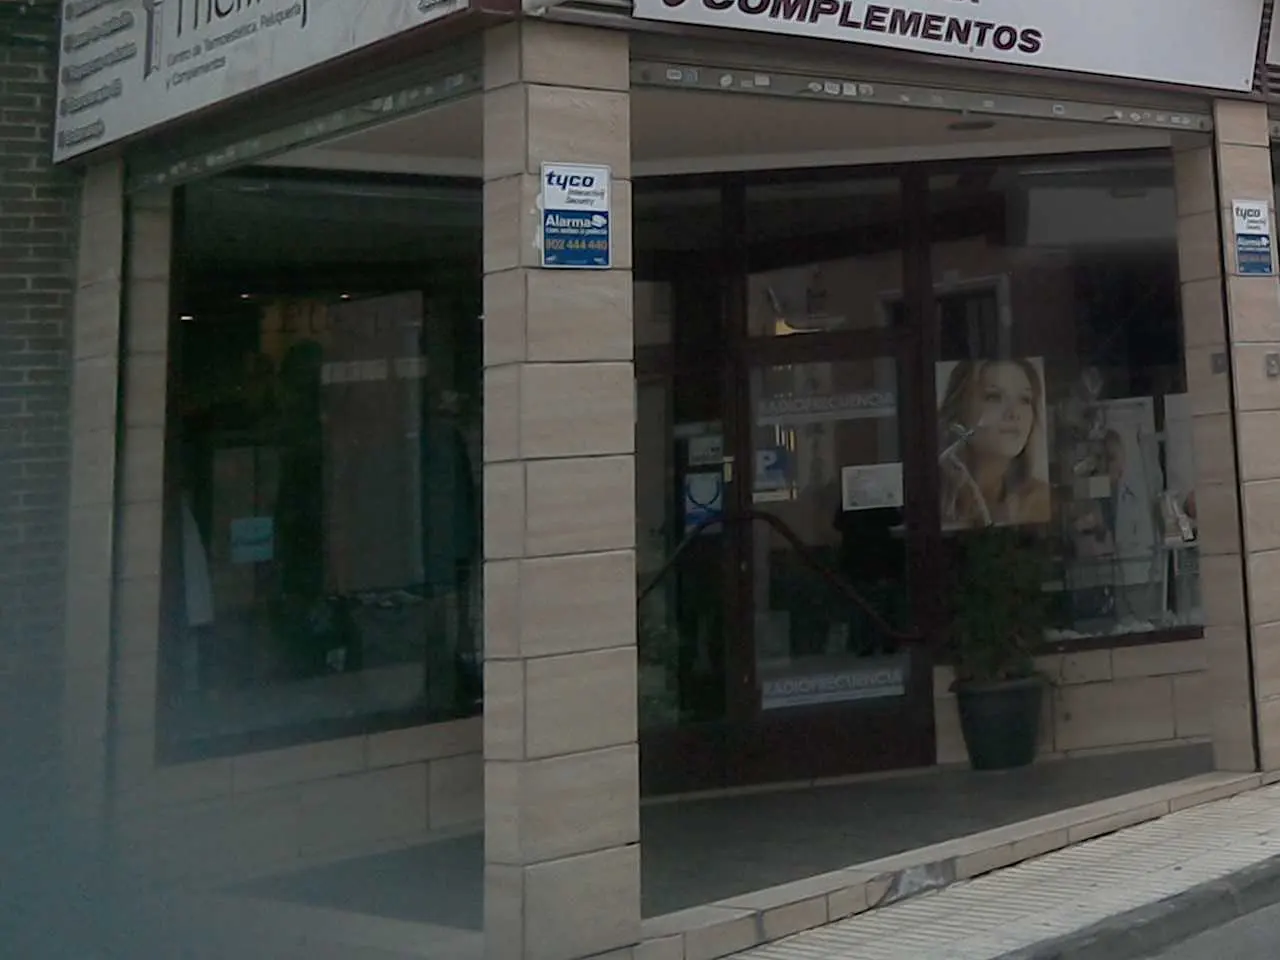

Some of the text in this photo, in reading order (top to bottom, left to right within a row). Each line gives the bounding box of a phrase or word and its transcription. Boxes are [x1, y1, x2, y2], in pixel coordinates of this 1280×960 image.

[546, 169, 596, 191] tyco
[545, 213, 592, 228] Alarma
[1235, 206, 1261, 220] tyco
